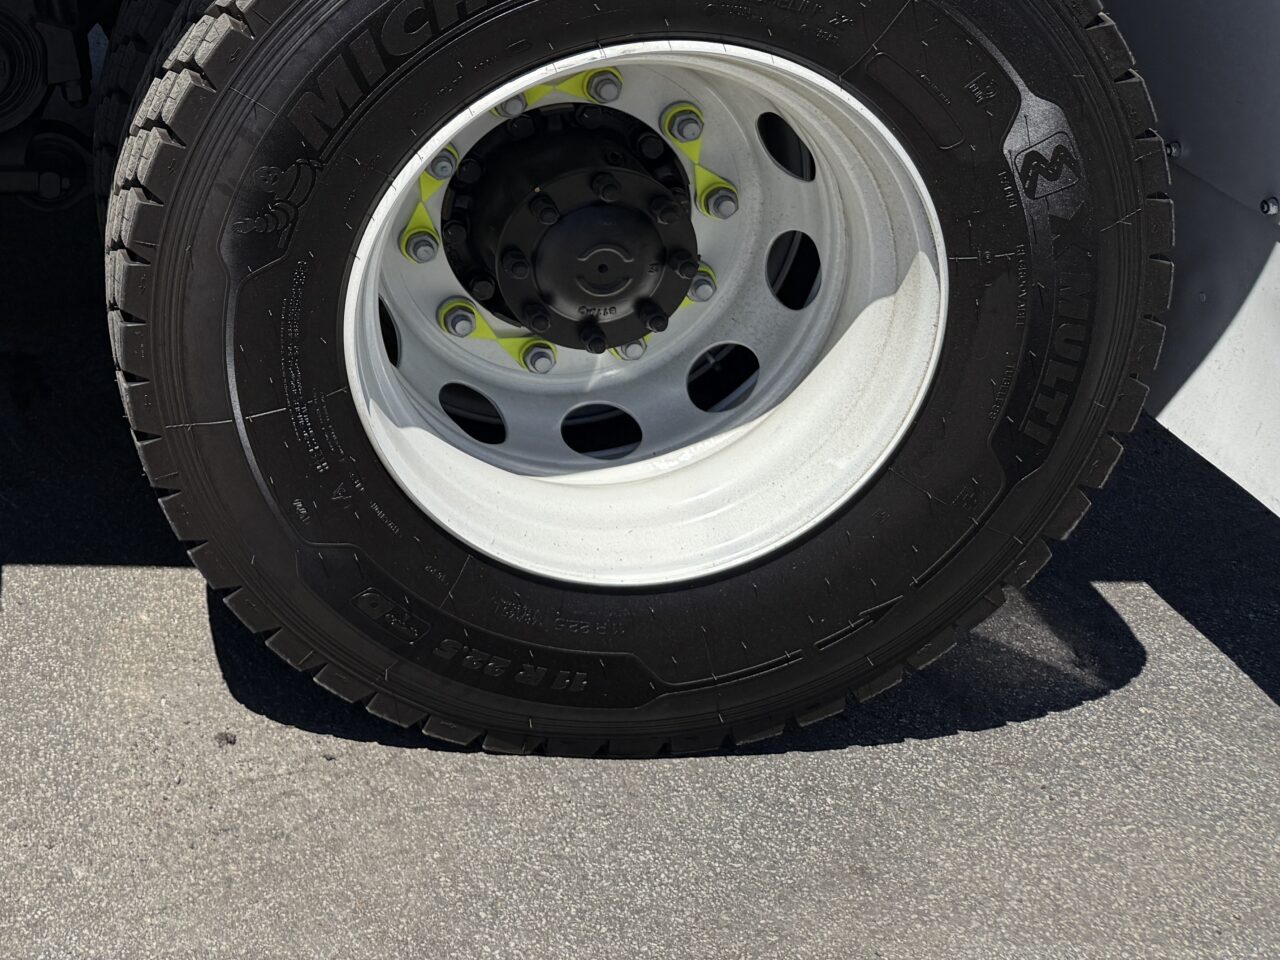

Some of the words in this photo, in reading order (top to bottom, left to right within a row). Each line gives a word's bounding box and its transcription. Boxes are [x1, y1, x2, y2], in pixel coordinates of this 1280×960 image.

[1022, 266, 1091, 448] MULTI
[432, 638, 512, 678] 22.5
[514, 663, 548, 687] R
[551, 670, 589, 692] 11
